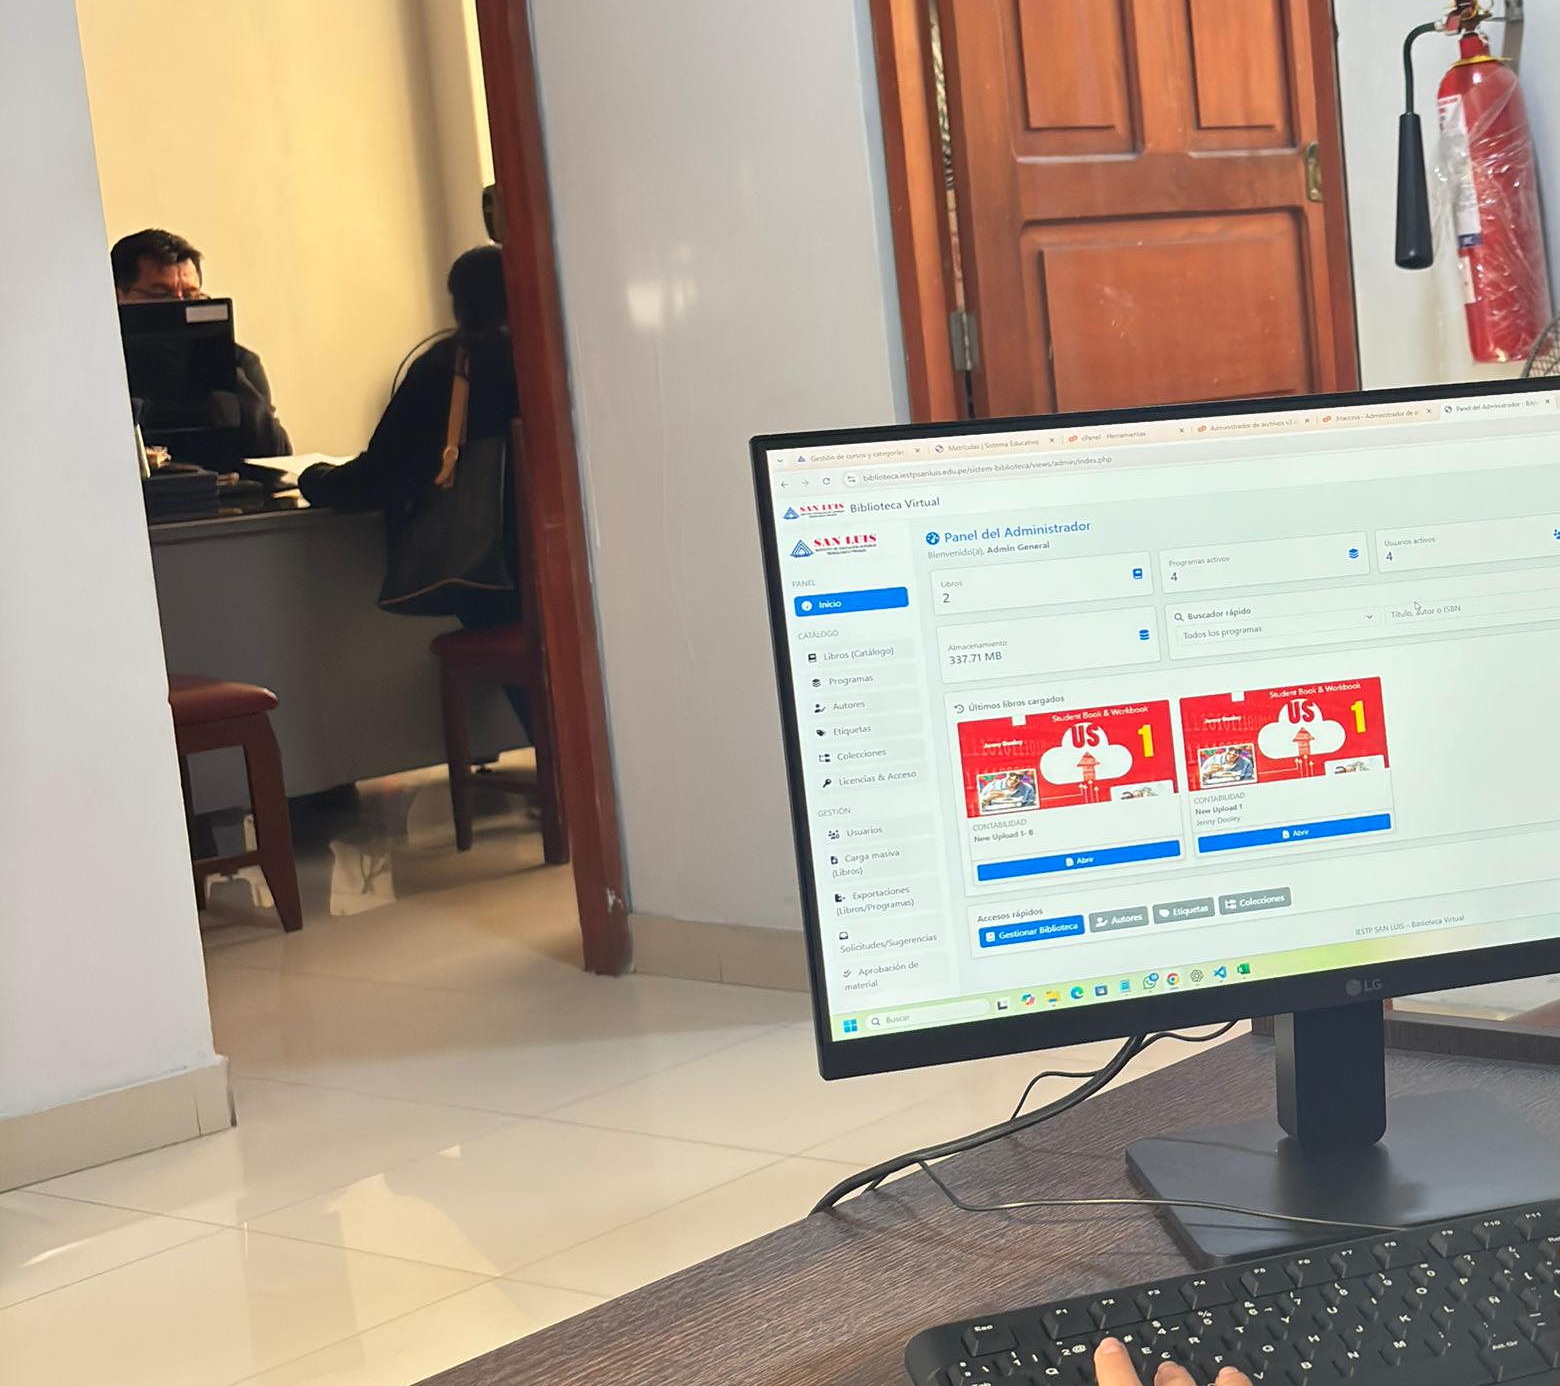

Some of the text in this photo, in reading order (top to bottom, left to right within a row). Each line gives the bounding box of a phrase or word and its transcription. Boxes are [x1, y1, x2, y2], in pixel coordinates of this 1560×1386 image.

[800, 504, 818, 512] SAN
[850, 497, 940, 513] Biblioteca Virtual
[944, 521, 1090, 543] Panel del Administrador
[814, 534, 877, 547] SAN LUIS
[1384, 536, 1436, 548] Usuarios activos
[987, 544, 1015, 554] Admin
[1018, 541, 1050, 551] General
[1386, 551, 1393, 561] 4
[1169, 558, 1205, 567] Programas
[1171, 572, 1178, 581] 4
[792, 580, 816, 588] PANEL
[819, 600, 842, 608] Inicio
[942, 593, 950, 603] 2
[1188, 608, 1251, 620] Buscador rápido
[1443, 604, 1461, 614] ISBN
[1184, 632, 1206, 640] Todos
[1222, 626, 1262, 637] programas
[824, 647, 894, 661] Libros (Catálogo)
[949, 651, 1002, 665] 337.71 MB
[829, 675, 874, 686] Programas
[1270, 689, 1297, 698] Student
[1299, 688, 1316, 696] Book
[1325, 682, 1360, 693] Workbook
[833, 701, 865, 710] Autores
[969, 695, 1065, 713] Últimos libros cargados
[1052, 713, 1081, 723] Student
[1083, 711, 1101, 720] Book
[1111, 705, 1149, 716] Workbook
[1351, 700, 1366, 733] 1
[834, 725, 872, 737] Etiquetas
[1138, 724, 1154, 757] 1
[837, 749, 887, 761] Colecciones
[839, 771, 917, 786] Licencias & Acceso
[1194, 792, 1245, 804] CONTABILIDAD
[1195, 807, 1211, 816] New
[1213, 805, 1238, 814] Upload
[973, 819, 1027, 831] CONTABILIDAD
[1196, 815, 1241, 827] Jenny Dooley
[847, 826, 882, 837] Usuarios
[974, 834, 990, 843] New
[993, 831, 1019, 840] Upload
[1293, 829, 1309, 837] Abrir
[845, 849, 900, 863] Carga masiva
[1077, 856, 1094, 864] Abrir
[832, 867, 863, 879] (Libros)
[852, 886, 910, 901] Exportaciones
[1239, 894, 1285, 907] Colecciones
[836, 899, 914, 917] (Libros/Programas)
[1172, 904, 1209, 917] Etiquetas
[978, 907, 1043, 923] Accesos rápidos
[1111, 914, 1142, 925] Autores
[1390, 923, 1405, 931] LUIS
[1412, 919, 1442, 928] Biblioteca
[1443, 915, 1464, 923] Virtual
[999, 922, 1078, 941] Gestionar Biblioteca
[840, 934, 937, 954] Solicitudes/Sugerencias
[858, 961, 919, 977] Aprobación de
[845, 979, 878, 991] material
[1364, 979, 1382, 992] LG
